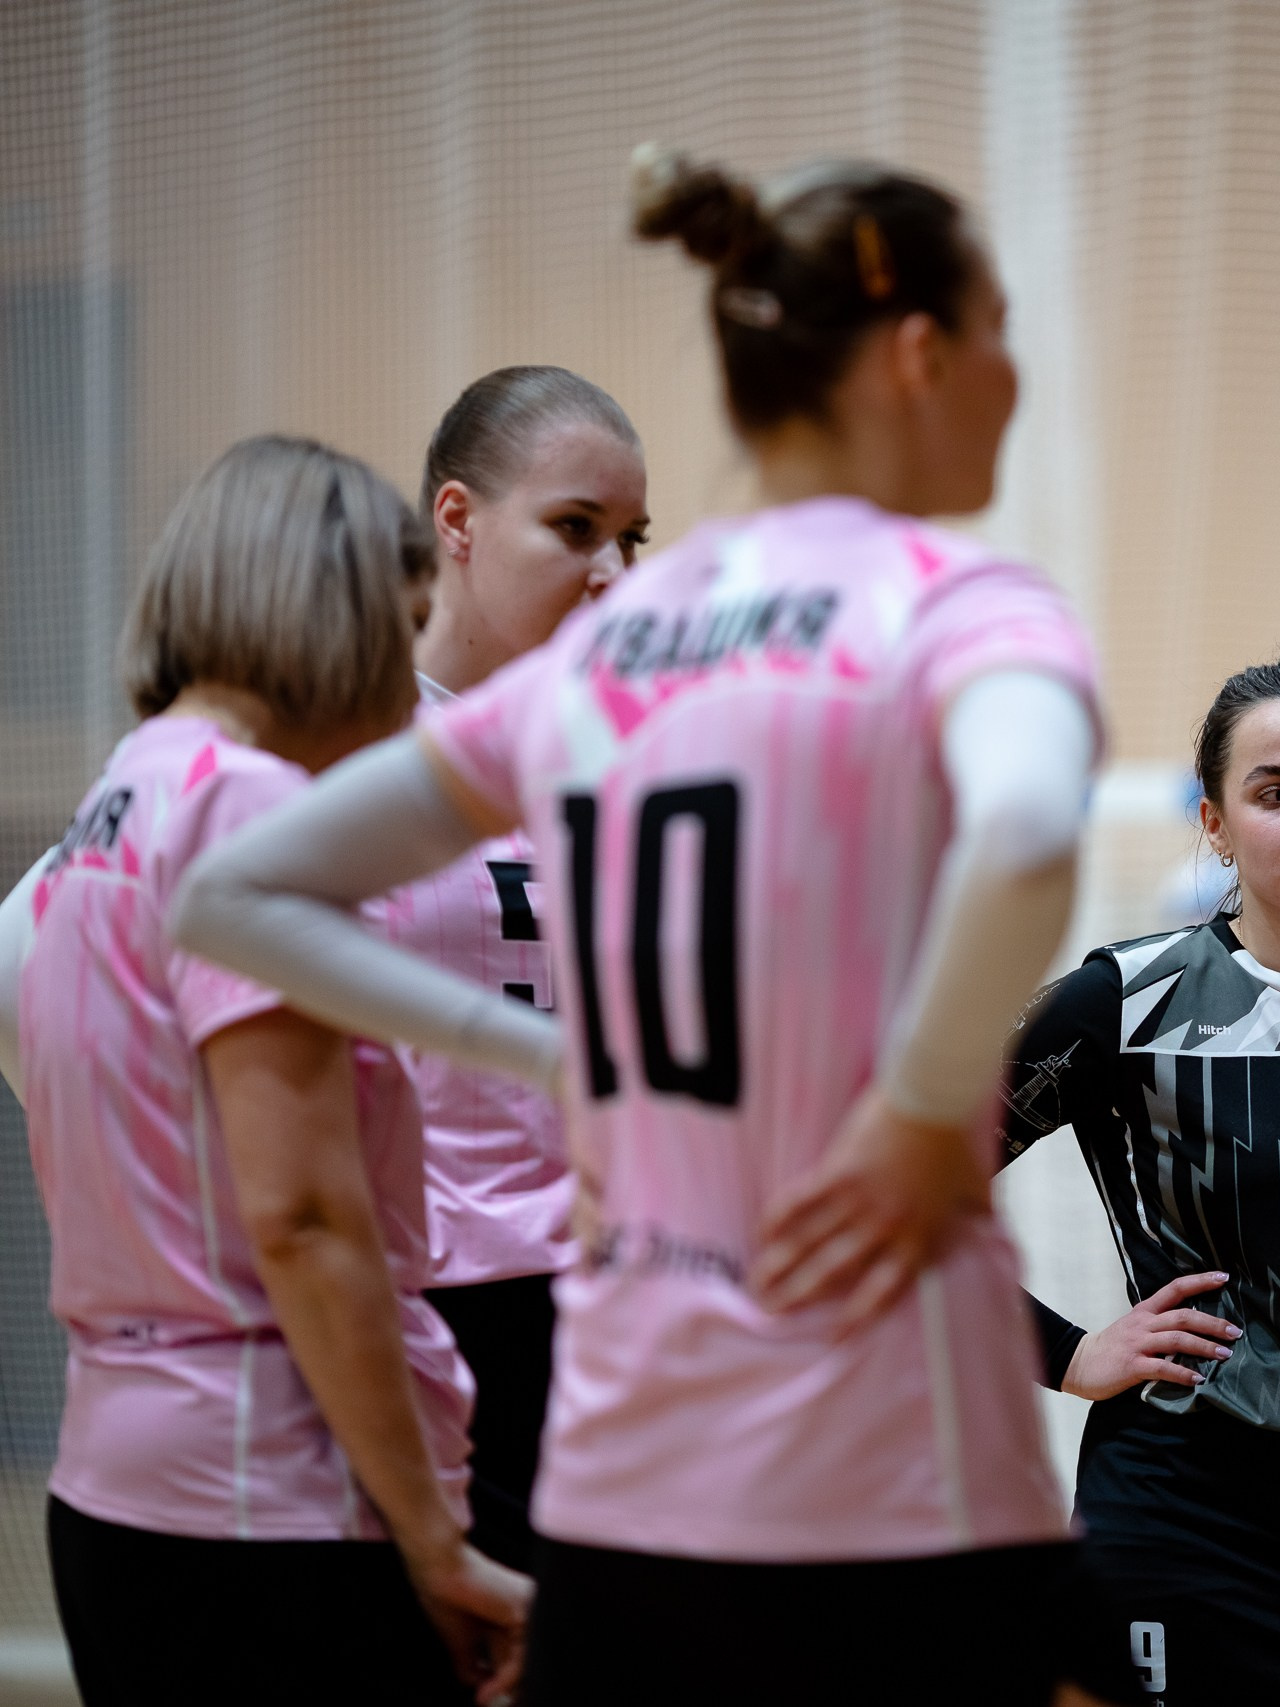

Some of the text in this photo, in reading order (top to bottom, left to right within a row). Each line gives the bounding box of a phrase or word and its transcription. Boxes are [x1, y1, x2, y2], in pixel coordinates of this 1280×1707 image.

[563, 782, 741, 1106] 10
[1198, 1025, 1232, 1035] Hitch
[1130, 1621, 1167, 1693] 9
